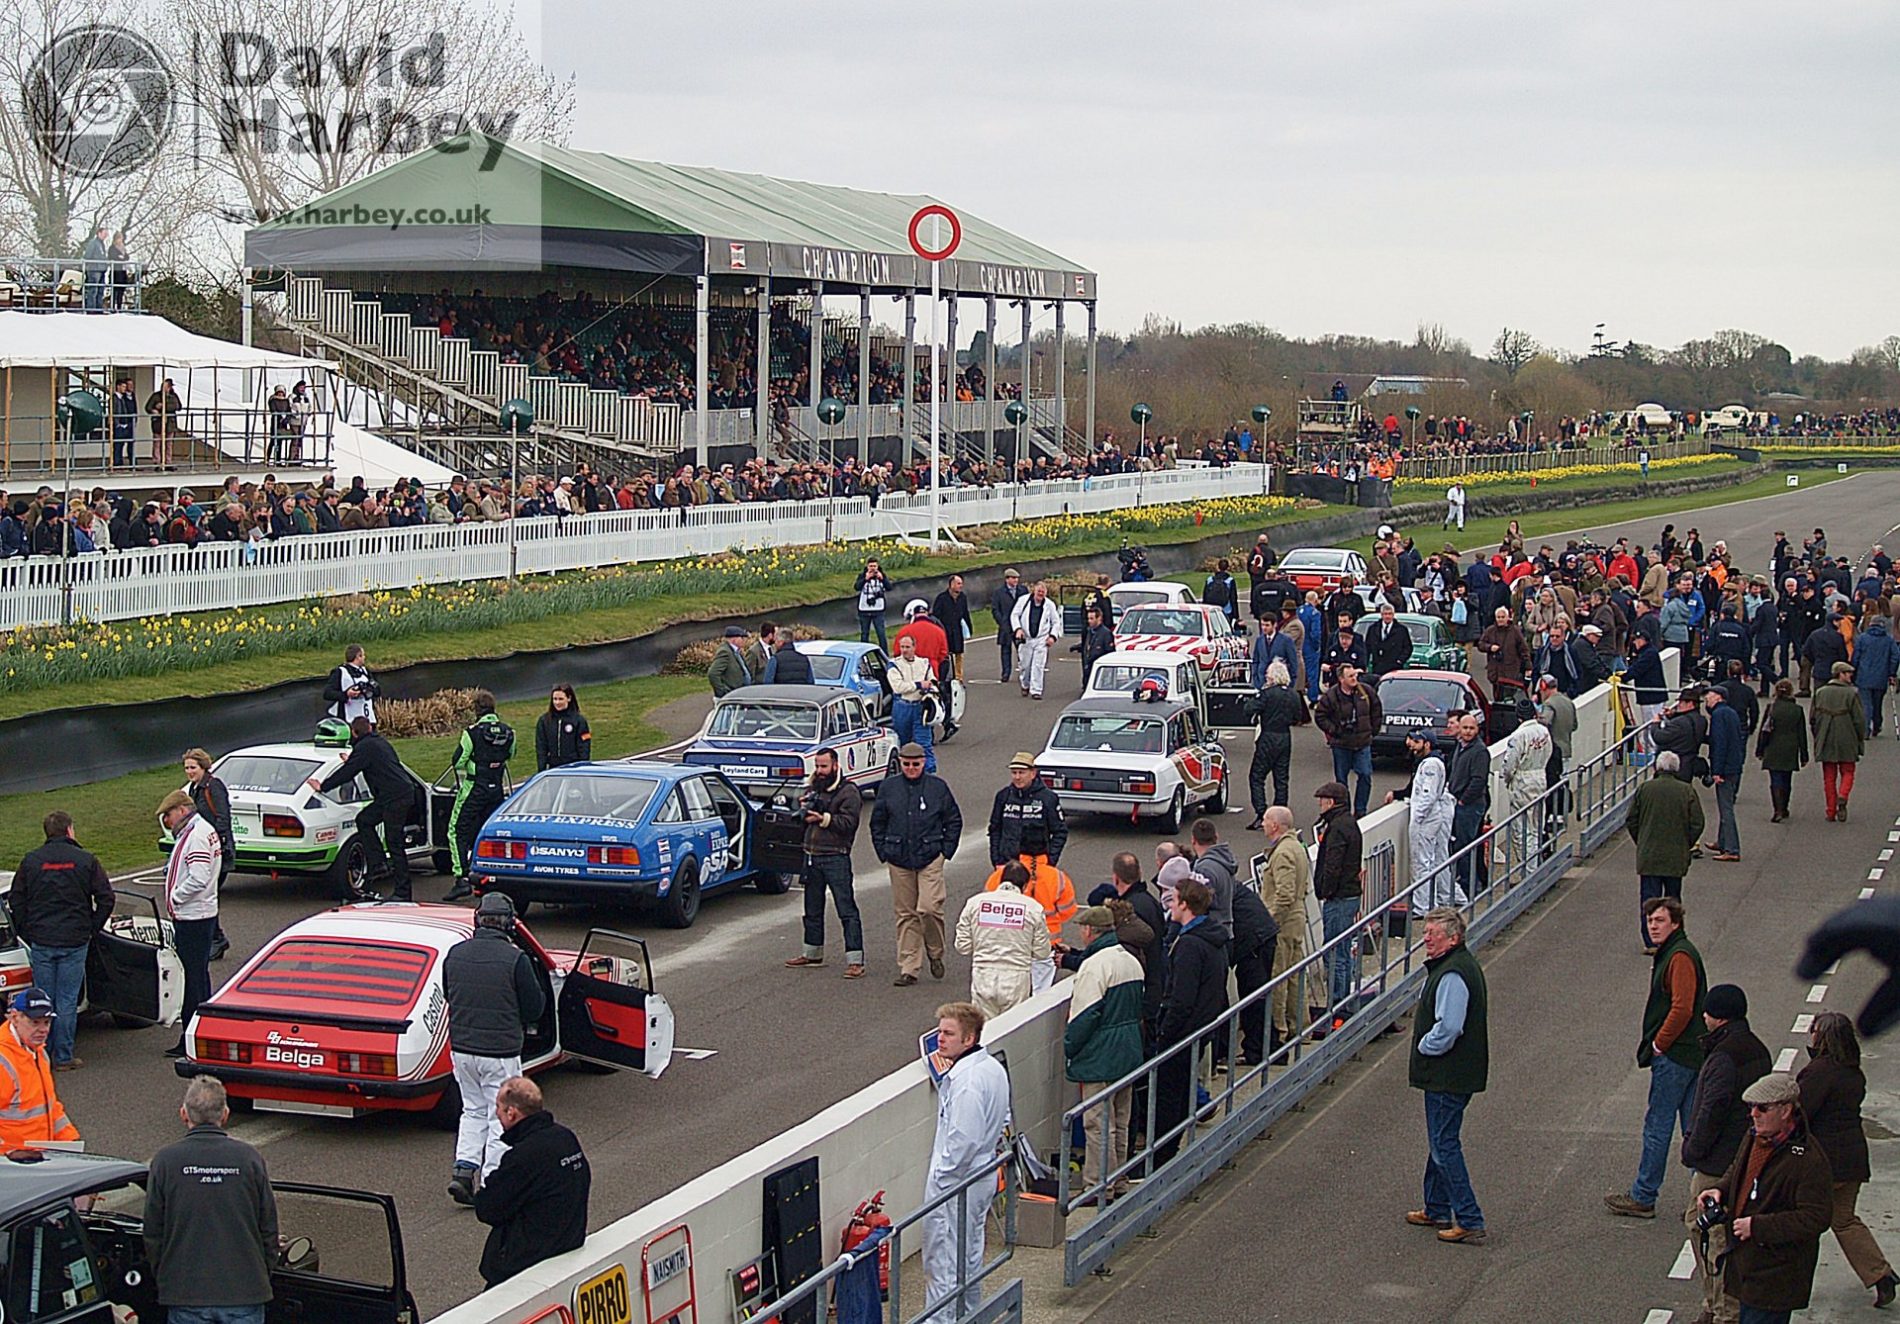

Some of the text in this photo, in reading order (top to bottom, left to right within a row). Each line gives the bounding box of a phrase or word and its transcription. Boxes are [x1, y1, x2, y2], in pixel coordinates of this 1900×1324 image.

[803, 246, 890, 284] CHAMPION
[980, 264, 1046, 297] CHAMPION
[363, 703, 370, 718] 6
[1385, 715, 1434, 727] PENTAX
[722, 766, 765, 775] Leyland Cars
[494, 814, 638, 829] DAILY EXPRESS
[537, 846, 586, 858] SANYO
[533, 865, 554, 873] AVON
[555, 866, 580, 874] TYRES
[980, 902, 1024, 918] Belga
[422, 982, 444, 1035] Castrol
[265, 1046, 325, 1069] Belga
[183, 1165, 240, 1175] GTSmotorsport
[200, 1175, 223, 1183] .co.uk
[652, 1248, 686, 1284] NAISMITH
[579, 1271, 628, 1324] PIRRO
